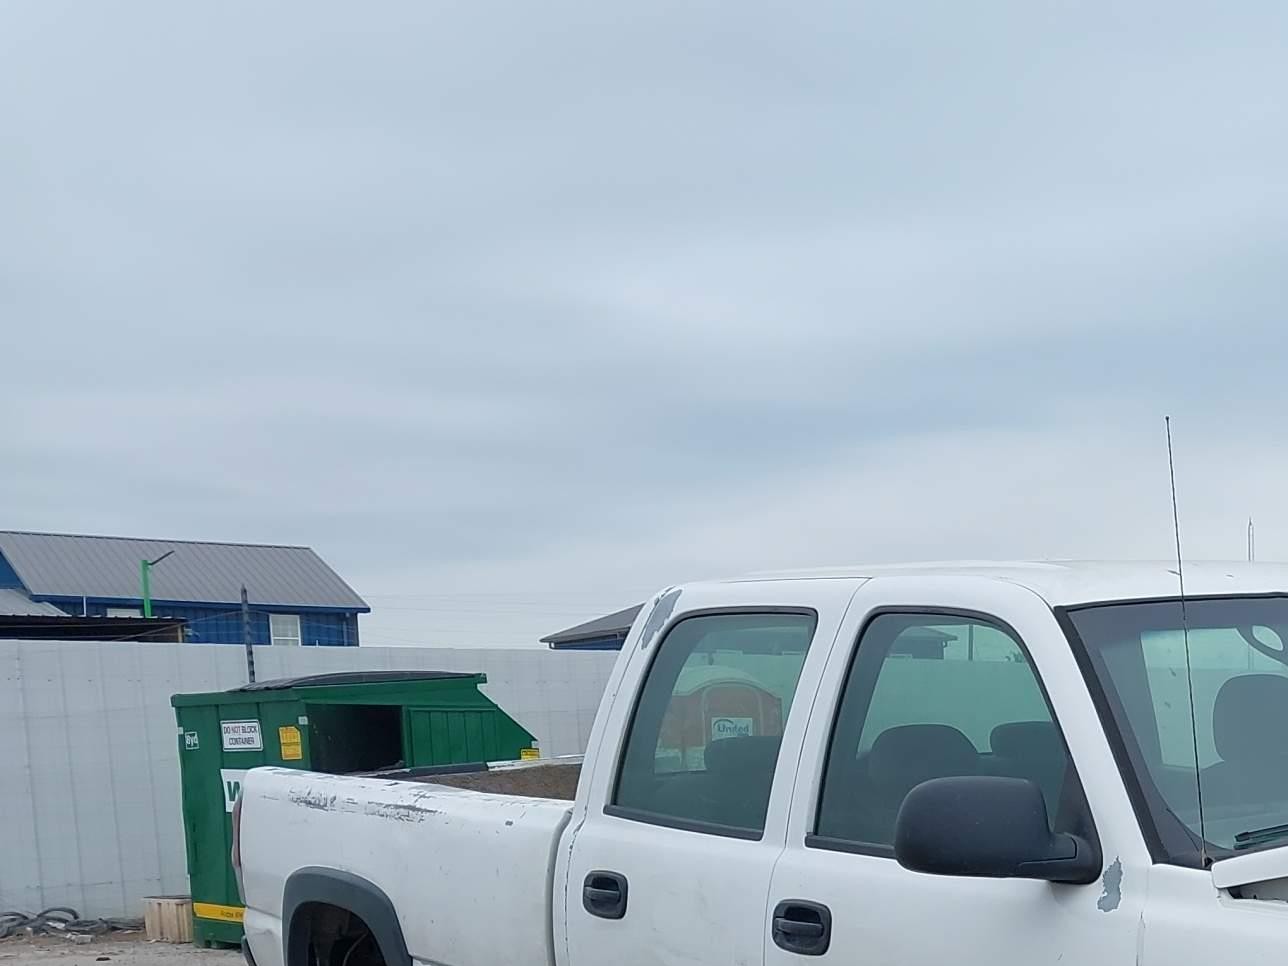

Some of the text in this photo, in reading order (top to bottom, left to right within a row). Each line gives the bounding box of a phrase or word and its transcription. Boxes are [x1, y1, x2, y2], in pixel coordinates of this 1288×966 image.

[223, 725, 258, 735] DO NOT BLOCK
[228, 737, 255, 745] CONTAINER
